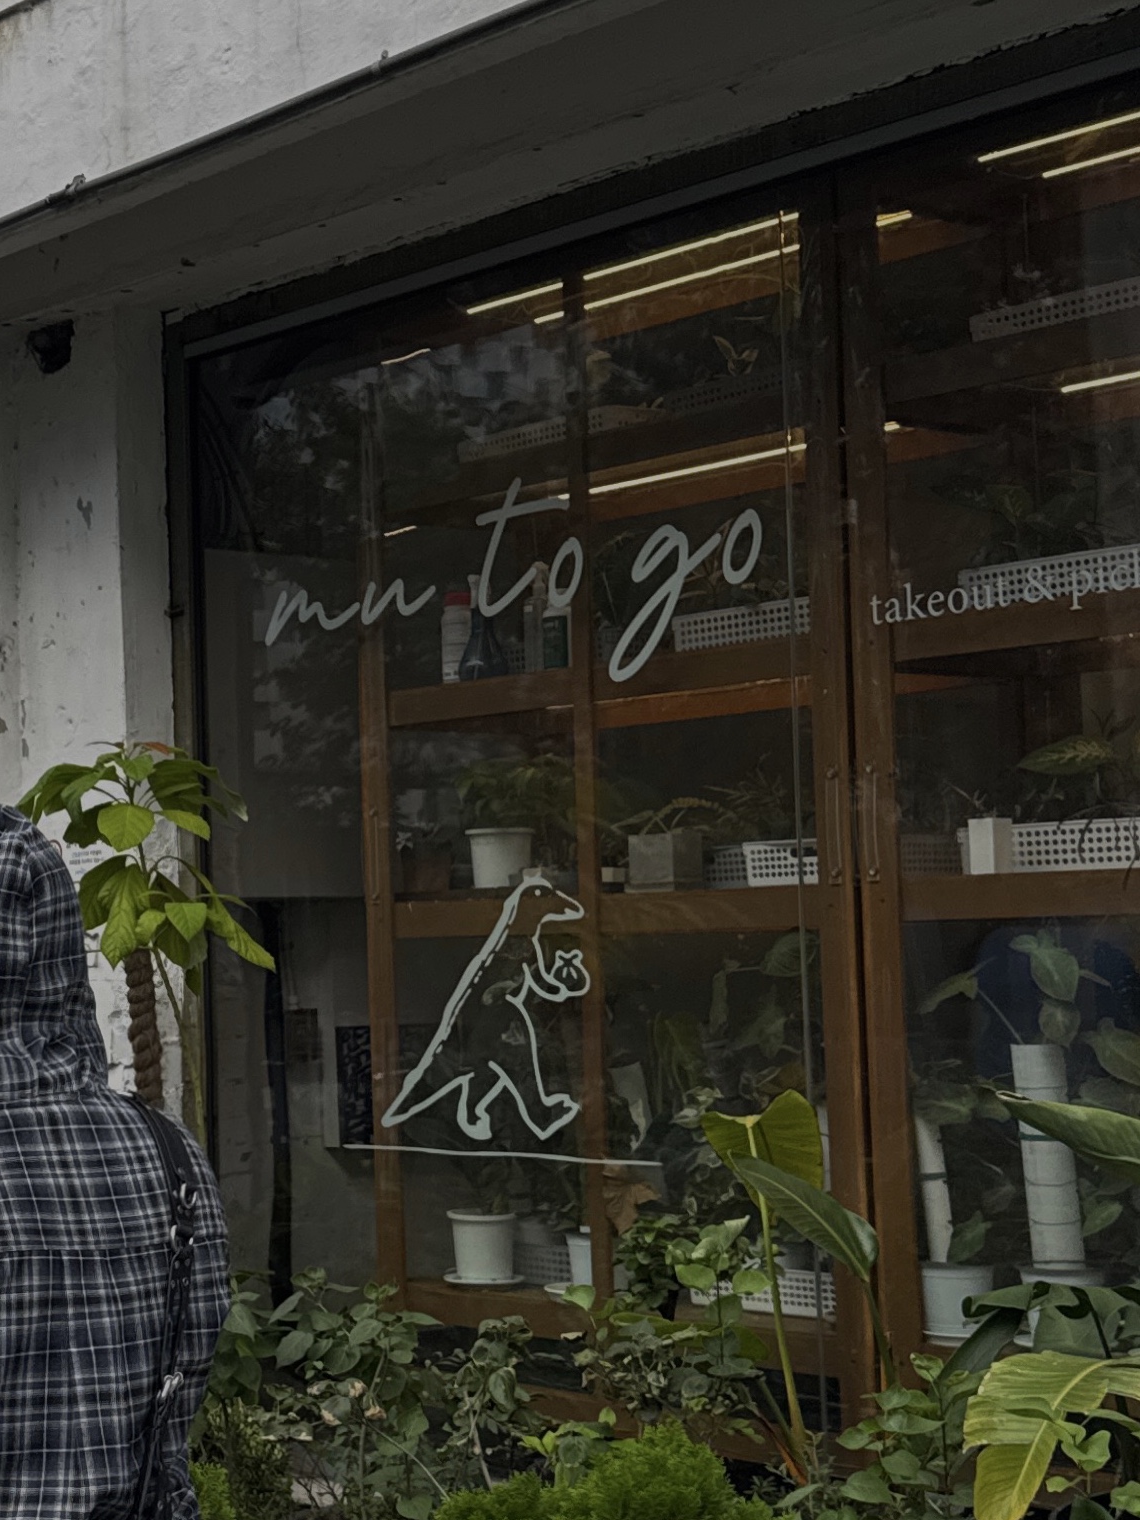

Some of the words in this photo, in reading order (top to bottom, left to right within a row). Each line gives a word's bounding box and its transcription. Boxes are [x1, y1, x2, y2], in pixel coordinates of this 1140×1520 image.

[475, 476, 584, 618] to
[608, 508, 764, 683] go
[869, 577, 1011, 626] takeout
[1023, 566, 1055, 604] &
